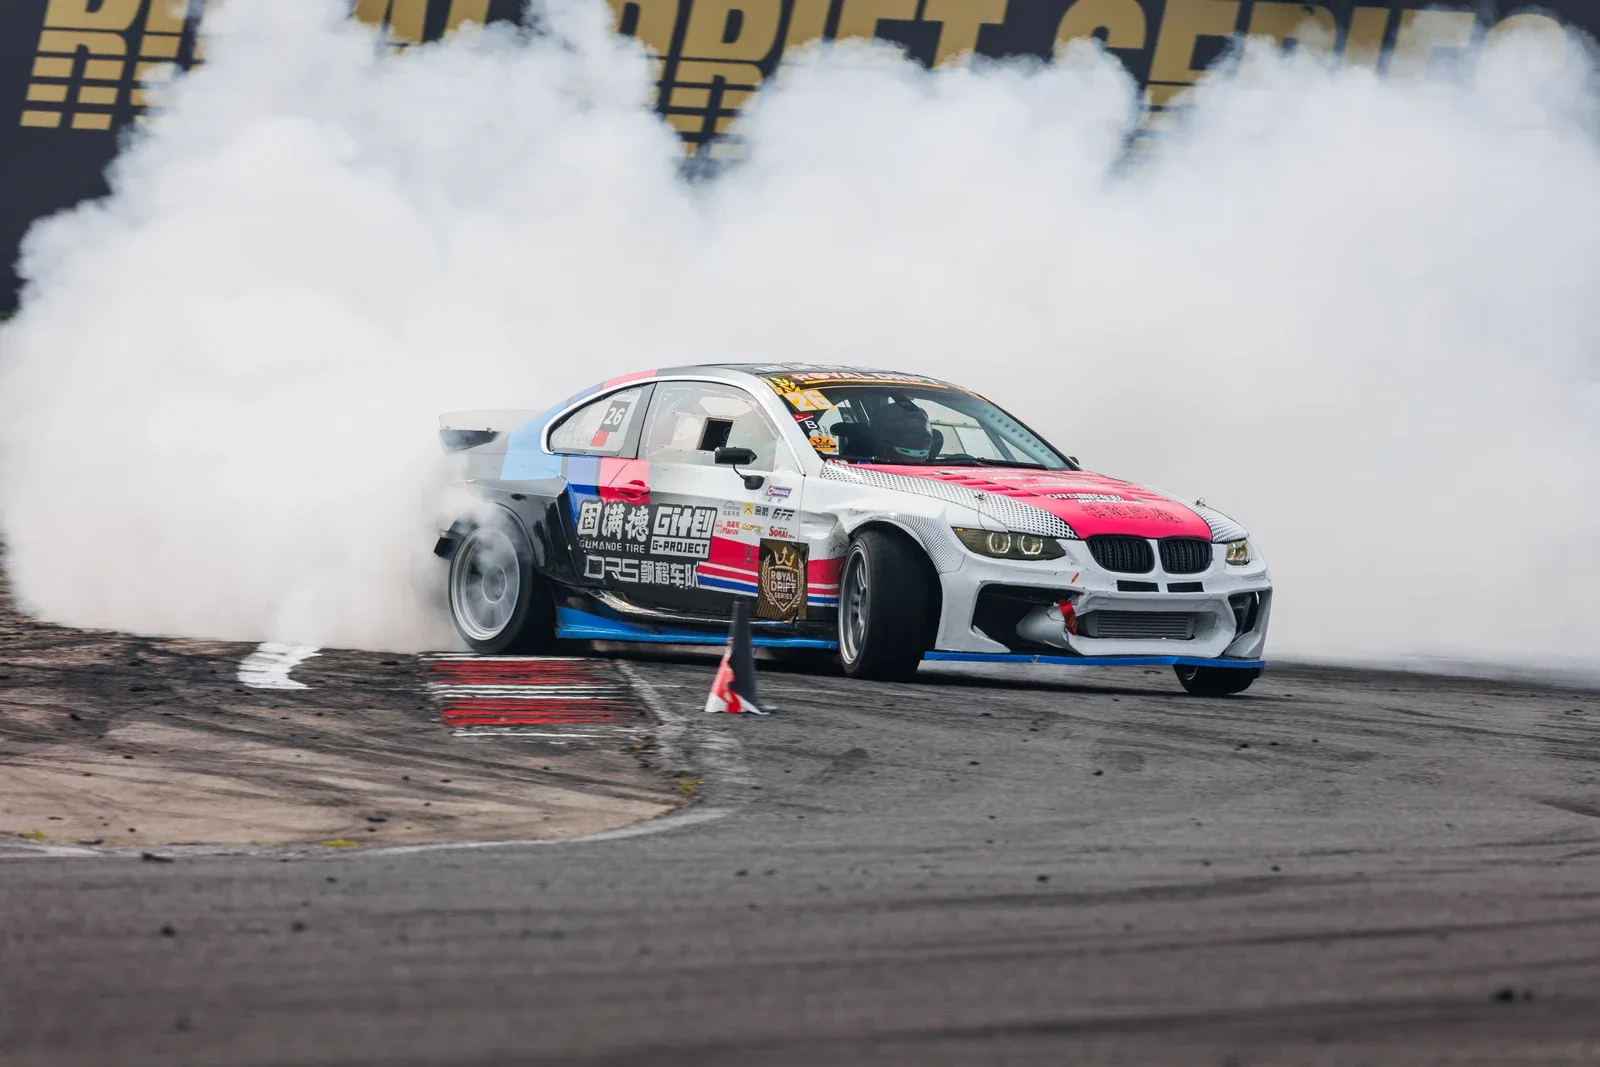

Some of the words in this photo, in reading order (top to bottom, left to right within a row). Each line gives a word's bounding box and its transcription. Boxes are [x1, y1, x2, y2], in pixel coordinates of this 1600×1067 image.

[787, 390, 832, 411] 26
[604, 406, 625, 426] 26
[804, 420, 818, 429] B
[579, 539, 623, 552] GUMANDE
[625, 543, 646, 554] TIRE
[651, 539, 709, 555] G-PROJECT
[770, 570, 797, 583] ROYAL
[770, 581, 797, 593] DRIFT
[773, 592, 793, 600] SERIES
